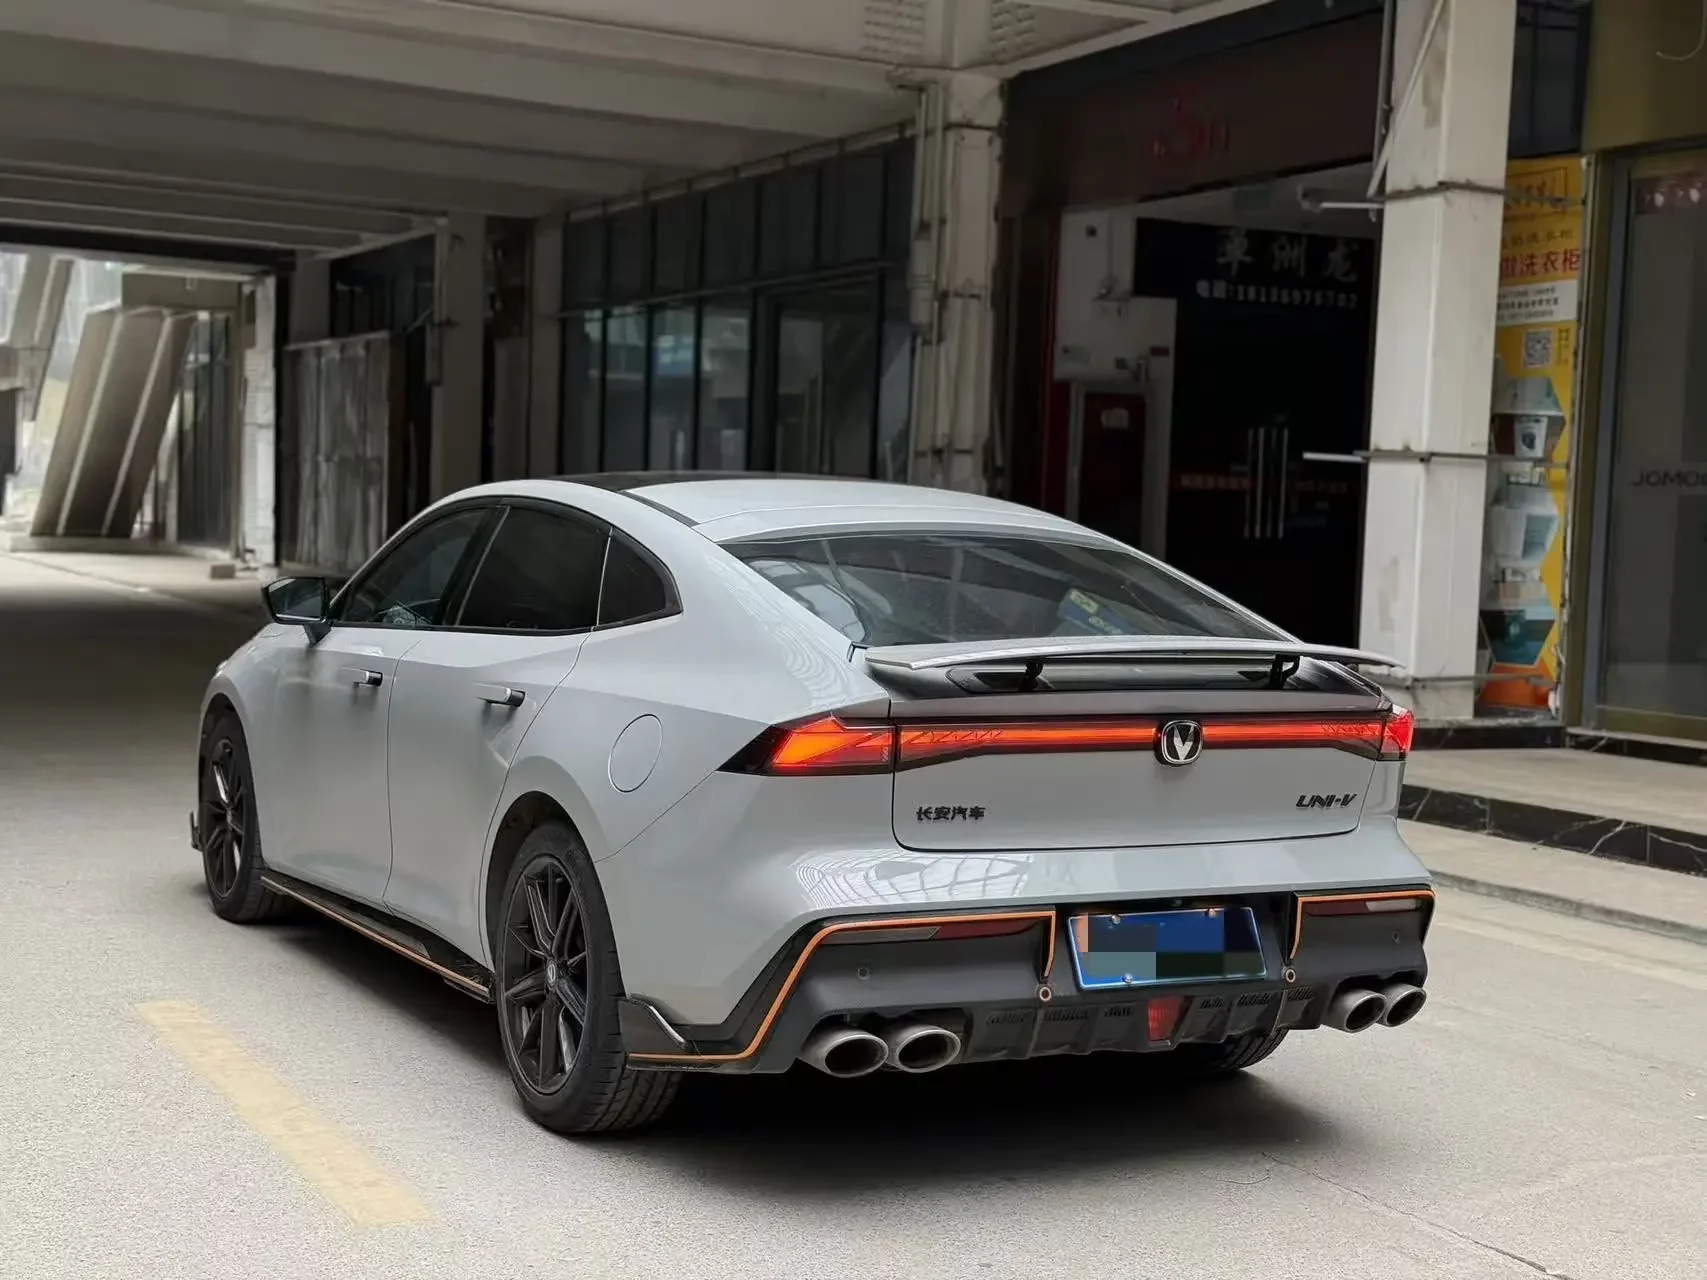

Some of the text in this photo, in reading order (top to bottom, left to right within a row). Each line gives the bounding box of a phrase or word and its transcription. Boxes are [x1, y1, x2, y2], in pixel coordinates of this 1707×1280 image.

[1296, 793, 1358, 808] UNI-V
[916, 805, 986, 821] 长安汽车
